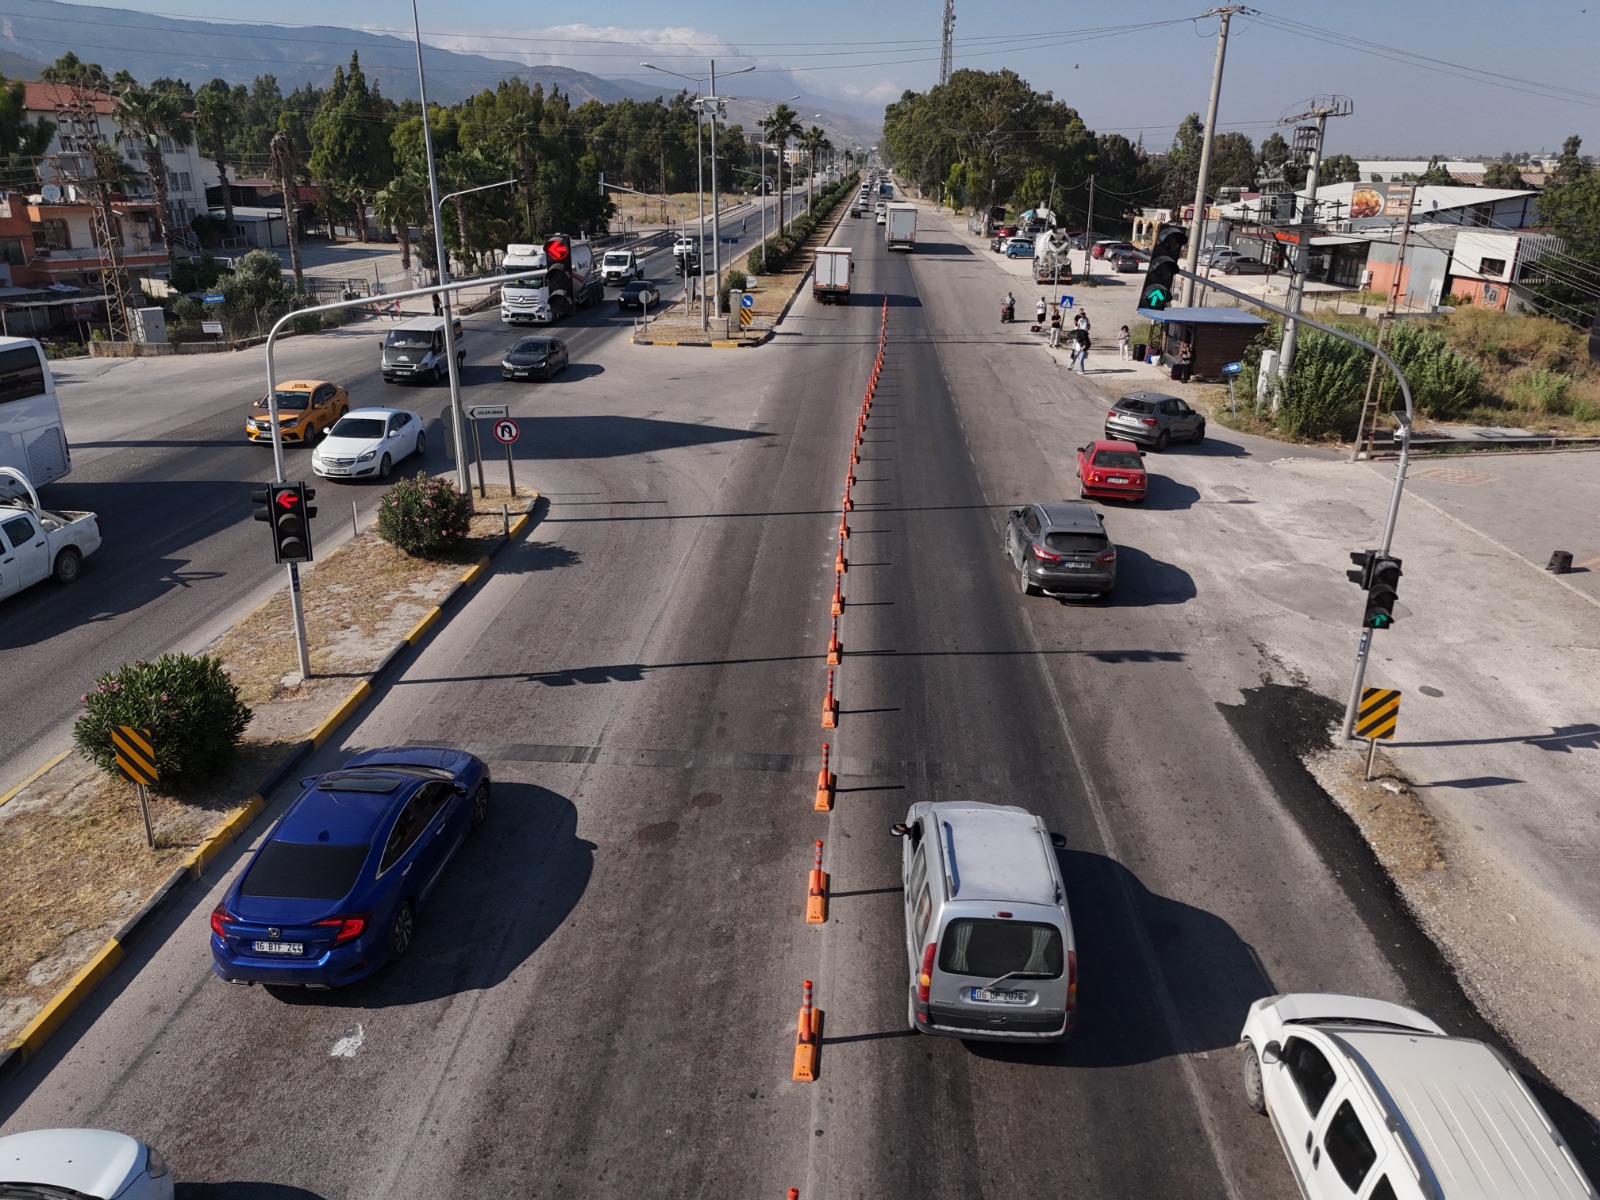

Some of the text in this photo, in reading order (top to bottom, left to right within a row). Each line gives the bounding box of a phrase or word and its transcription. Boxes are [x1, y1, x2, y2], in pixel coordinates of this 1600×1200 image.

[256, 941, 302, 952] 16 BTF 244
[976, 990, 987, 999] 06
[1003, 992, 1024, 1001] 2076
